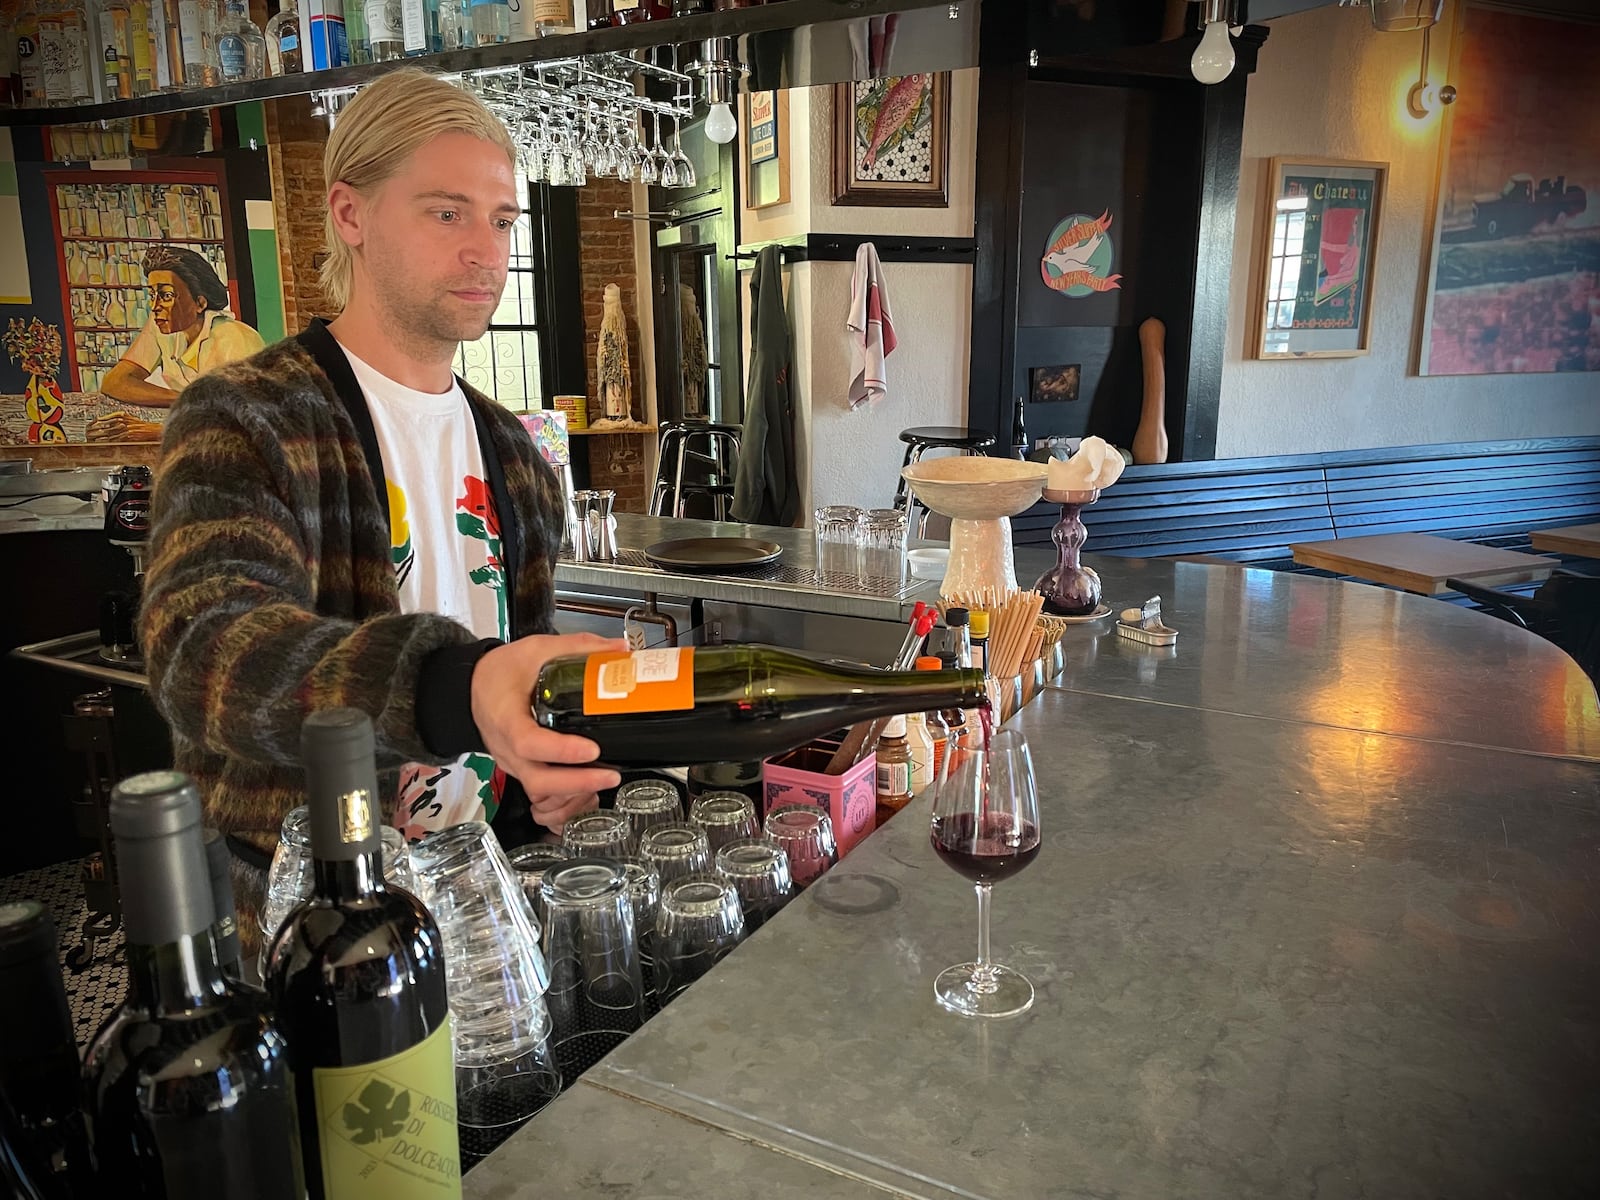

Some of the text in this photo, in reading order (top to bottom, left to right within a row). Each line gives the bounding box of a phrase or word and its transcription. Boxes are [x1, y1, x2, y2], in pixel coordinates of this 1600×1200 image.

[18, 38, 32, 55] 51
[761, 123, 772, 138] CLUB
[1313, 182, 1368, 201] Chateau
[406, 1117, 426, 1137] DI
